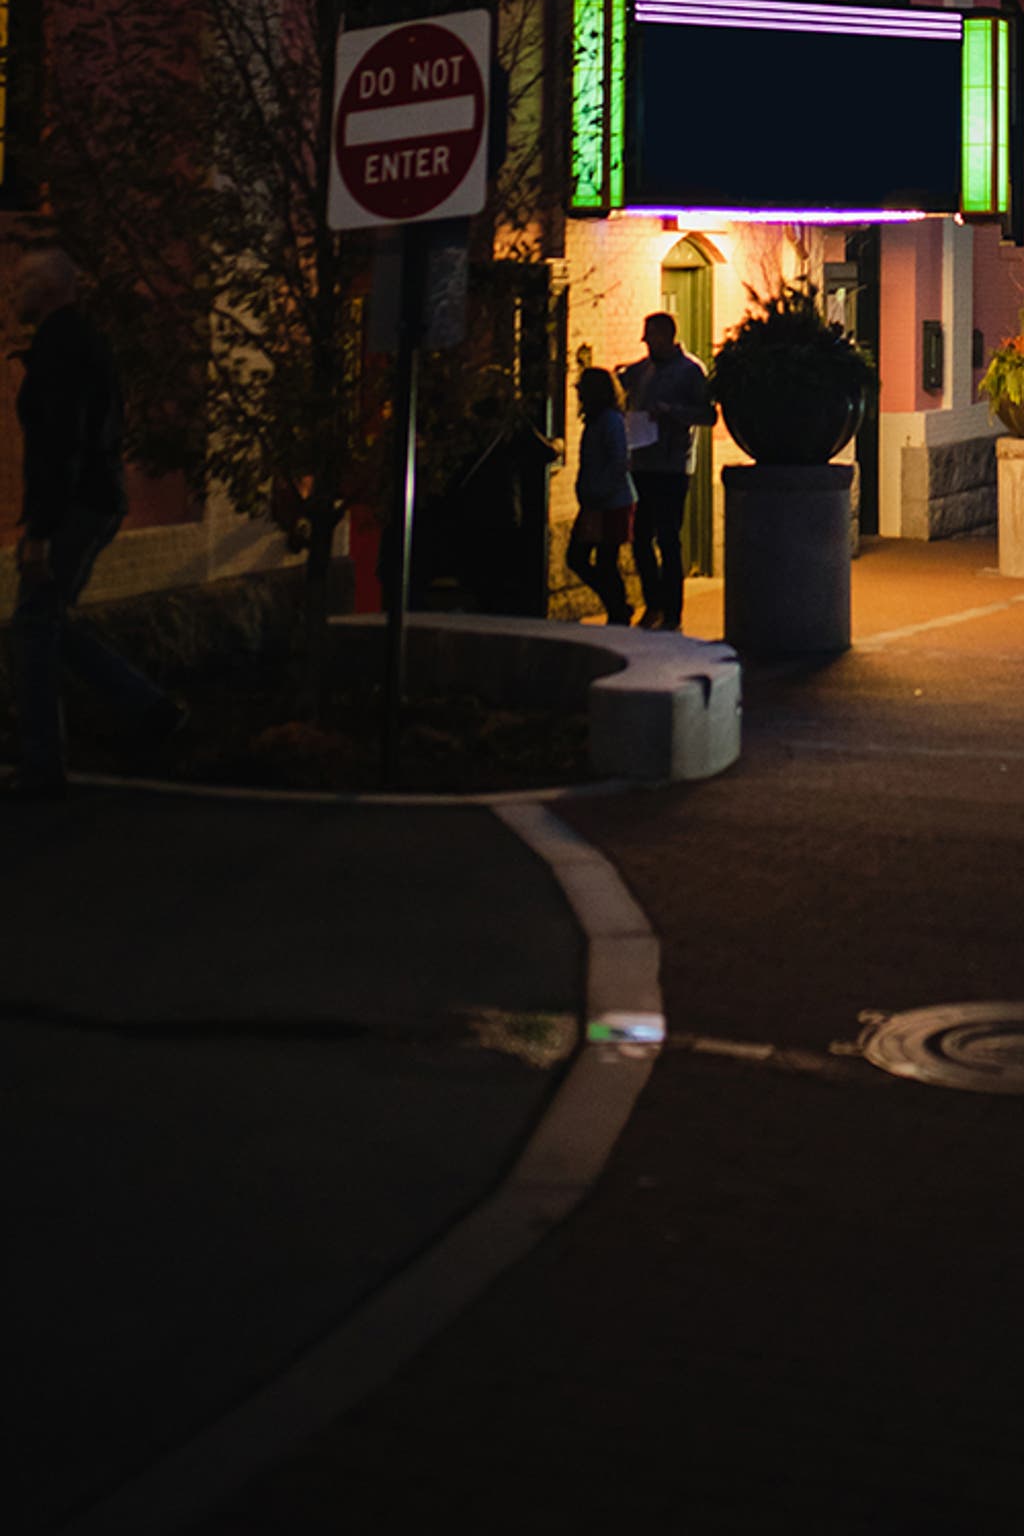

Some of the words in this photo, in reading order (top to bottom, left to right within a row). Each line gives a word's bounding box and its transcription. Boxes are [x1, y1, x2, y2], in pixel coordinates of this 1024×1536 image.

[359, 67, 396, 99] DO
[412, 55, 464, 91] NOT
[364, 146, 450, 184] ENTER
